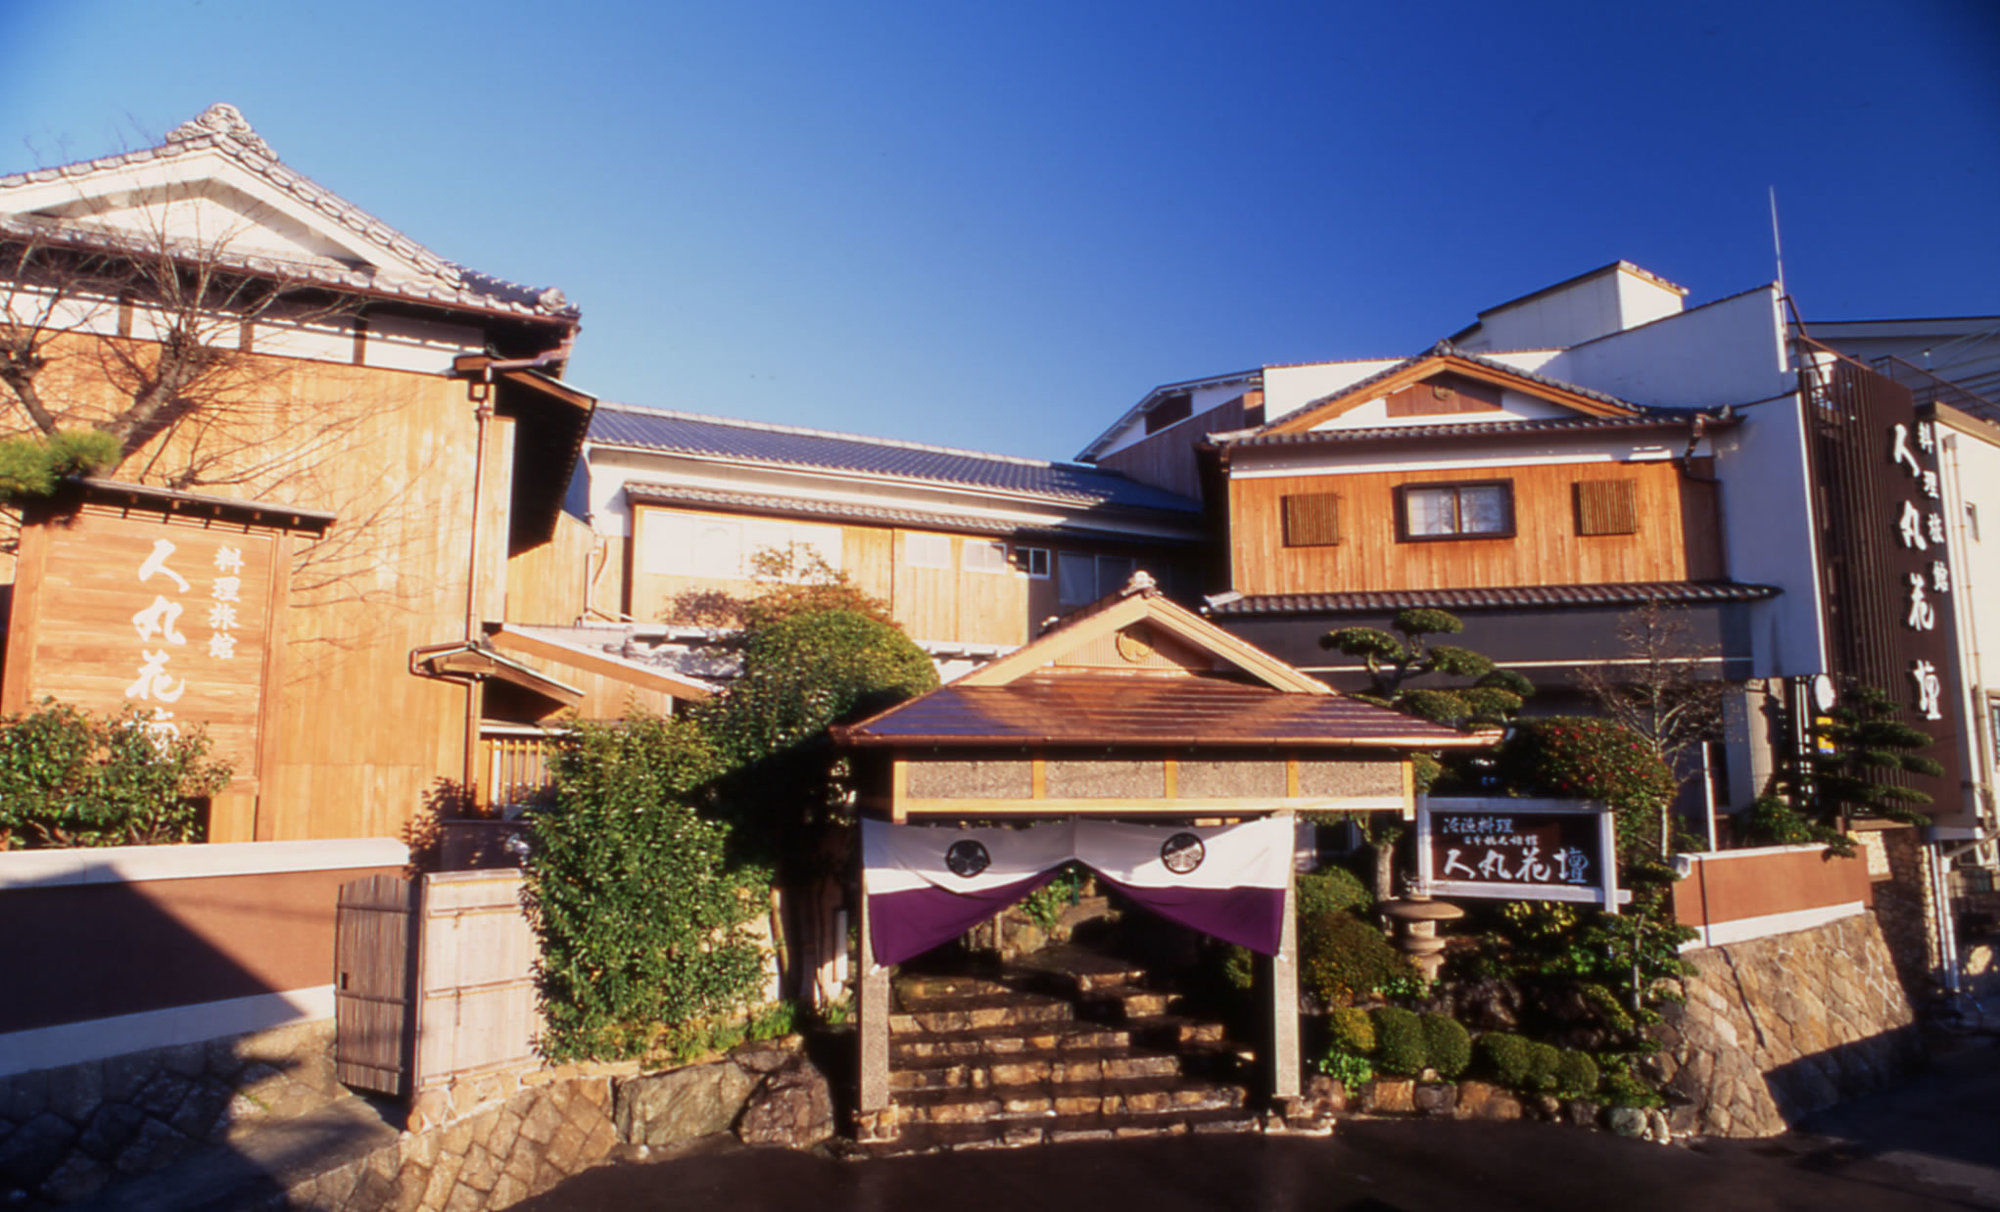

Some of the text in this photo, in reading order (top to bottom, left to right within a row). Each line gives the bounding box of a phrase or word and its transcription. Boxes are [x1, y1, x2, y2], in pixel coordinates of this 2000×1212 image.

[1893, 423, 1942, 720] 人丸花壇
[1918, 421, 1949, 592] 料理旅館
[208, 545, 245, 659] 料理旅館
[1444, 847, 1588, 883] 人丸花壇
